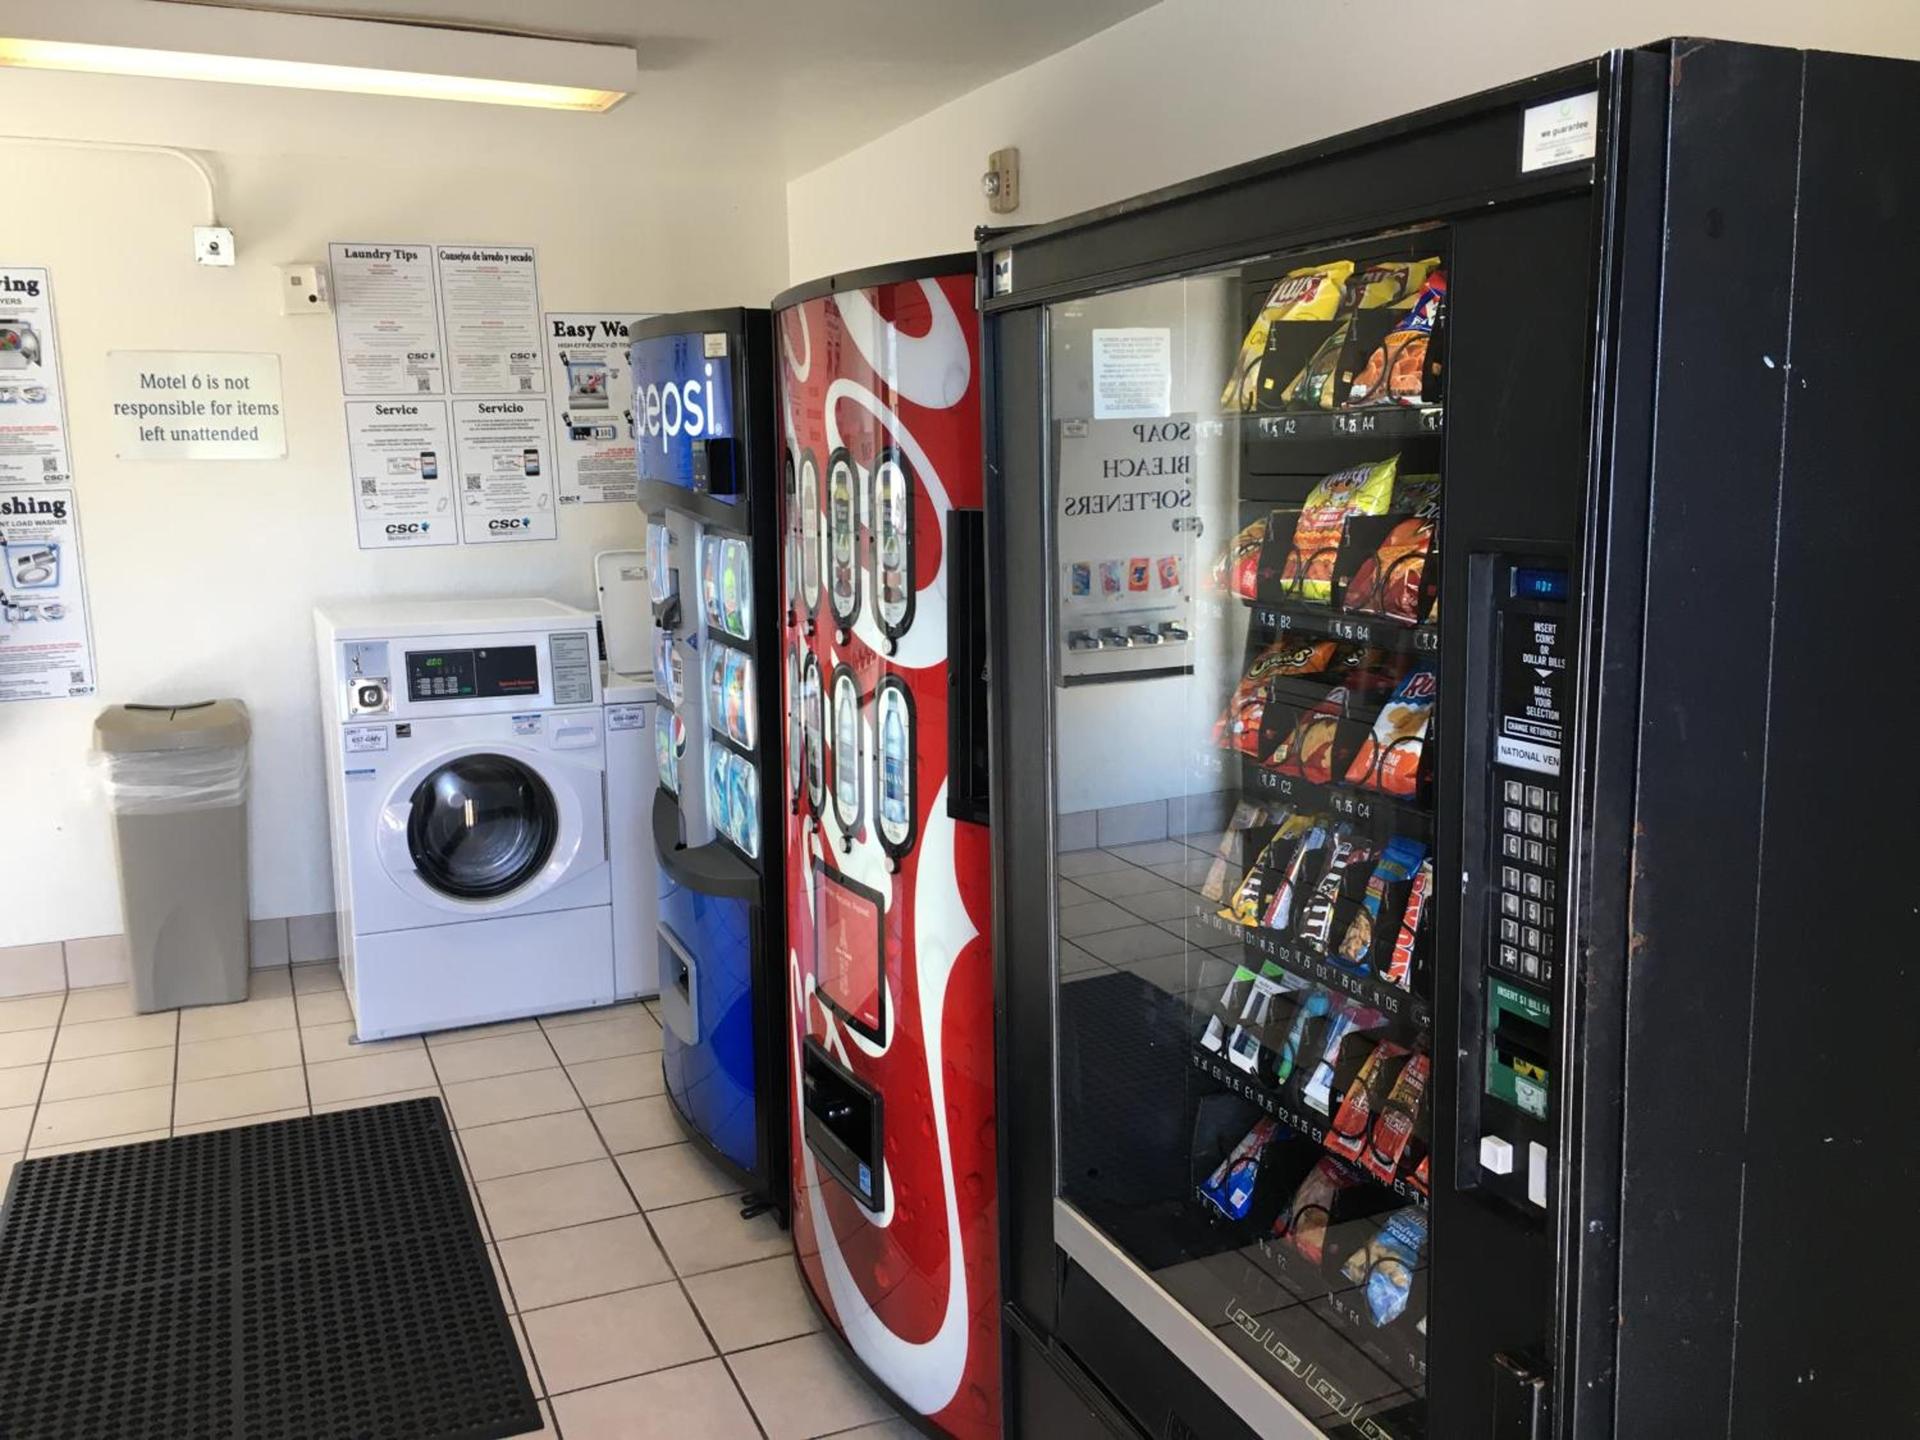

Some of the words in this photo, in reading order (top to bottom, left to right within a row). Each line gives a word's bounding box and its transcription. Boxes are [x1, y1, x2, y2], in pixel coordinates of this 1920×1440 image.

[344, 248, 392, 262] Laundry
[393, 249, 418, 262] Tips
[0, 275, 40, 297] ing
[553, 320, 597, 342] Easy
[600, 320, 630, 338] Wa
[407, 352, 429, 360] CSC
[510, 352, 531, 360] CSC
[140, 373, 187, 390] Motel
[191, 373, 202, 390] 6
[206, 374, 220, 390] is
[224, 375, 251, 390] not
[113, 400, 206, 419] responsible
[210, 401, 233, 416] for
[236, 402, 280, 416] items
[375, 403, 419, 416] Service
[477, 402, 524, 415] Servicio
[635, 363, 715, 454] pepsi
[139, 426, 165, 441] left
[170, 427, 259, 442] unattended
[385, 523, 419, 534] CSC
[488, 518, 521, 530] CSC
[1533, 621, 1557, 635] INSERT
[1535, 633, 1555, 646] COINS
[1539, 644, 1550, 656] OR
[1522, 653, 1547, 666] DOLLAR
[1547, 656, 1566, 670] BILLS
[1533, 685, 1553, 698] MAKE
[1534, 696, 1552, 709] YOUR
[1526, 705, 1560, 721] SELECTION
[1507, 721, 1529, 734] CHANGE
[1529, 725, 1557, 740] RETURNED
[1500, 745, 1541, 763] NATIONAL
[1542, 754, 1560, 767] VEN
[1496, 985, 1518, 1003] INSERT
[1527, 998, 1541, 1012] BILL
